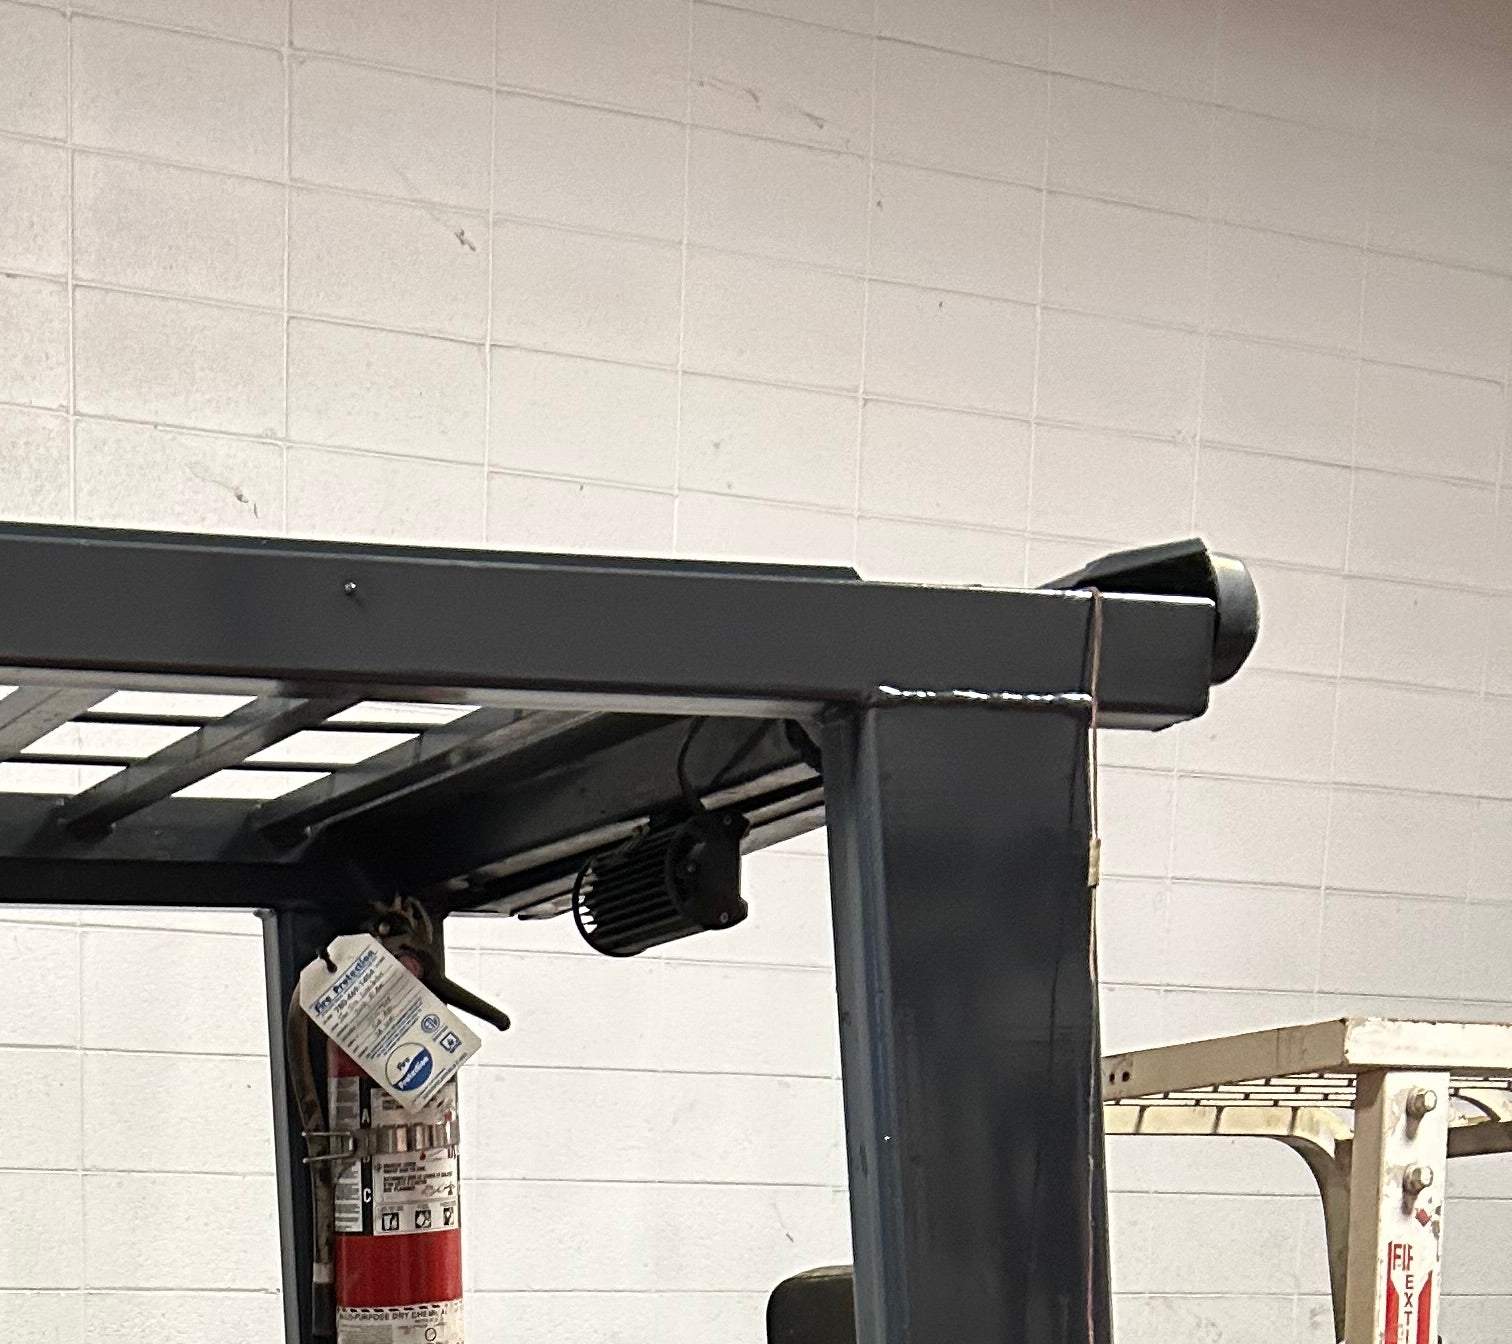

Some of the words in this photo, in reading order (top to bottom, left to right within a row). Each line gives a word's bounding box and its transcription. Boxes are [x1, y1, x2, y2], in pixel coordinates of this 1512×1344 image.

[333, 949, 377, 994] Protection
[398, 1056, 430, 1089] Protection
[363, 1187, 372, 1203] C
